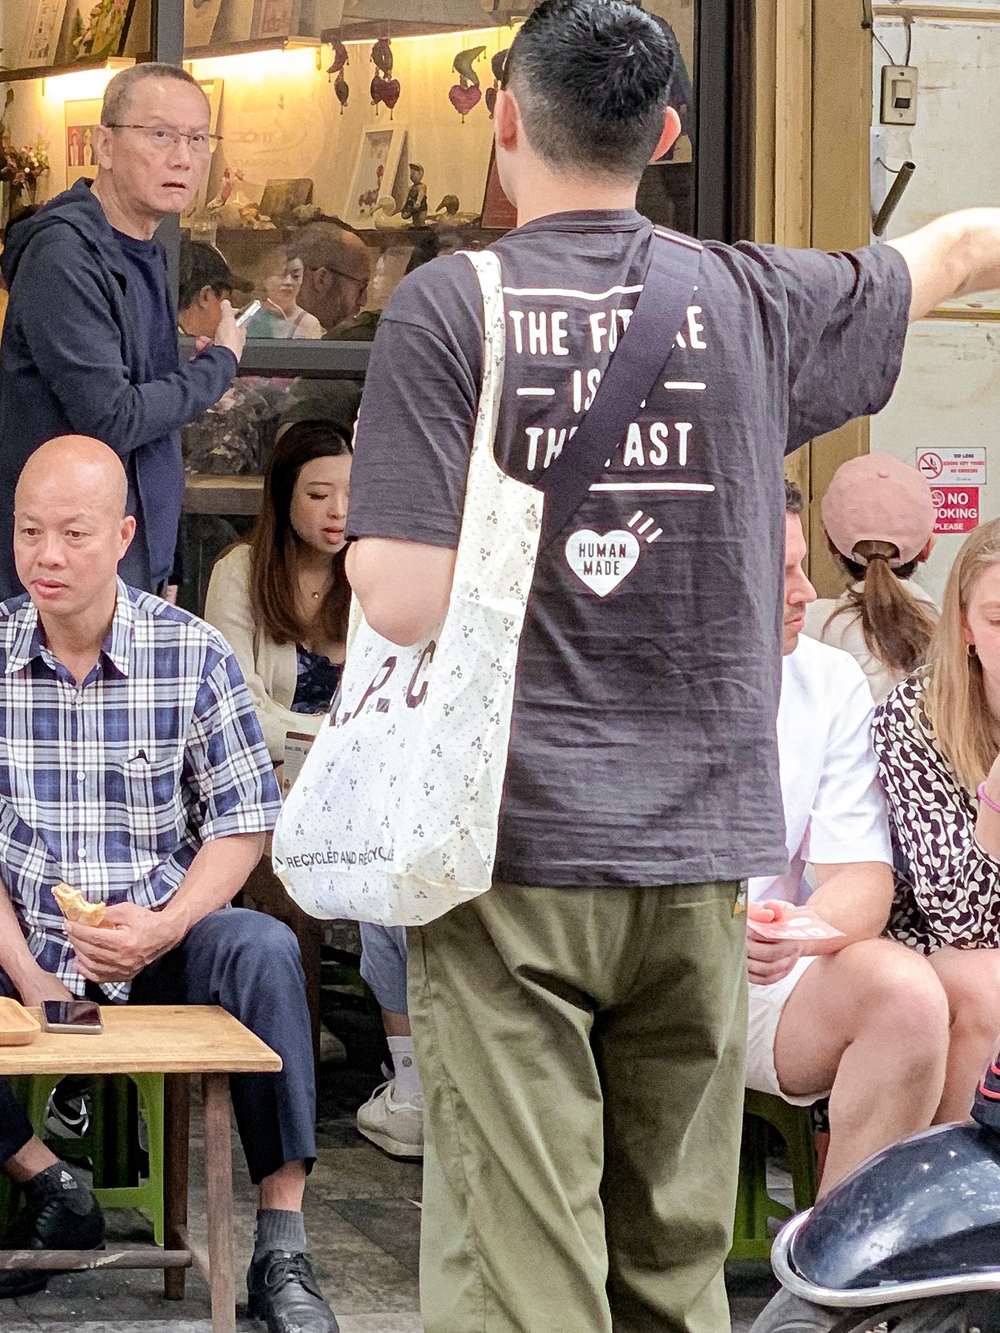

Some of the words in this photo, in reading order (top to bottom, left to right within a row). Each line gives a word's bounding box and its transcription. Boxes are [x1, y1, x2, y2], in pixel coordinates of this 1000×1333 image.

[508, 310, 570, 356] THE
[525, 425, 579, 471] TH
[605, 421, 693, 468] AST
[947, 492, 969, 506] NO
[935, 522, 964, 531] PLEASE
[578, 542, 627, 559] HUMAN
[583, 560, 621, 576] MADE
[285, 851, 339, 869] RECYCLED
[340, 850, 357, 865] AND
